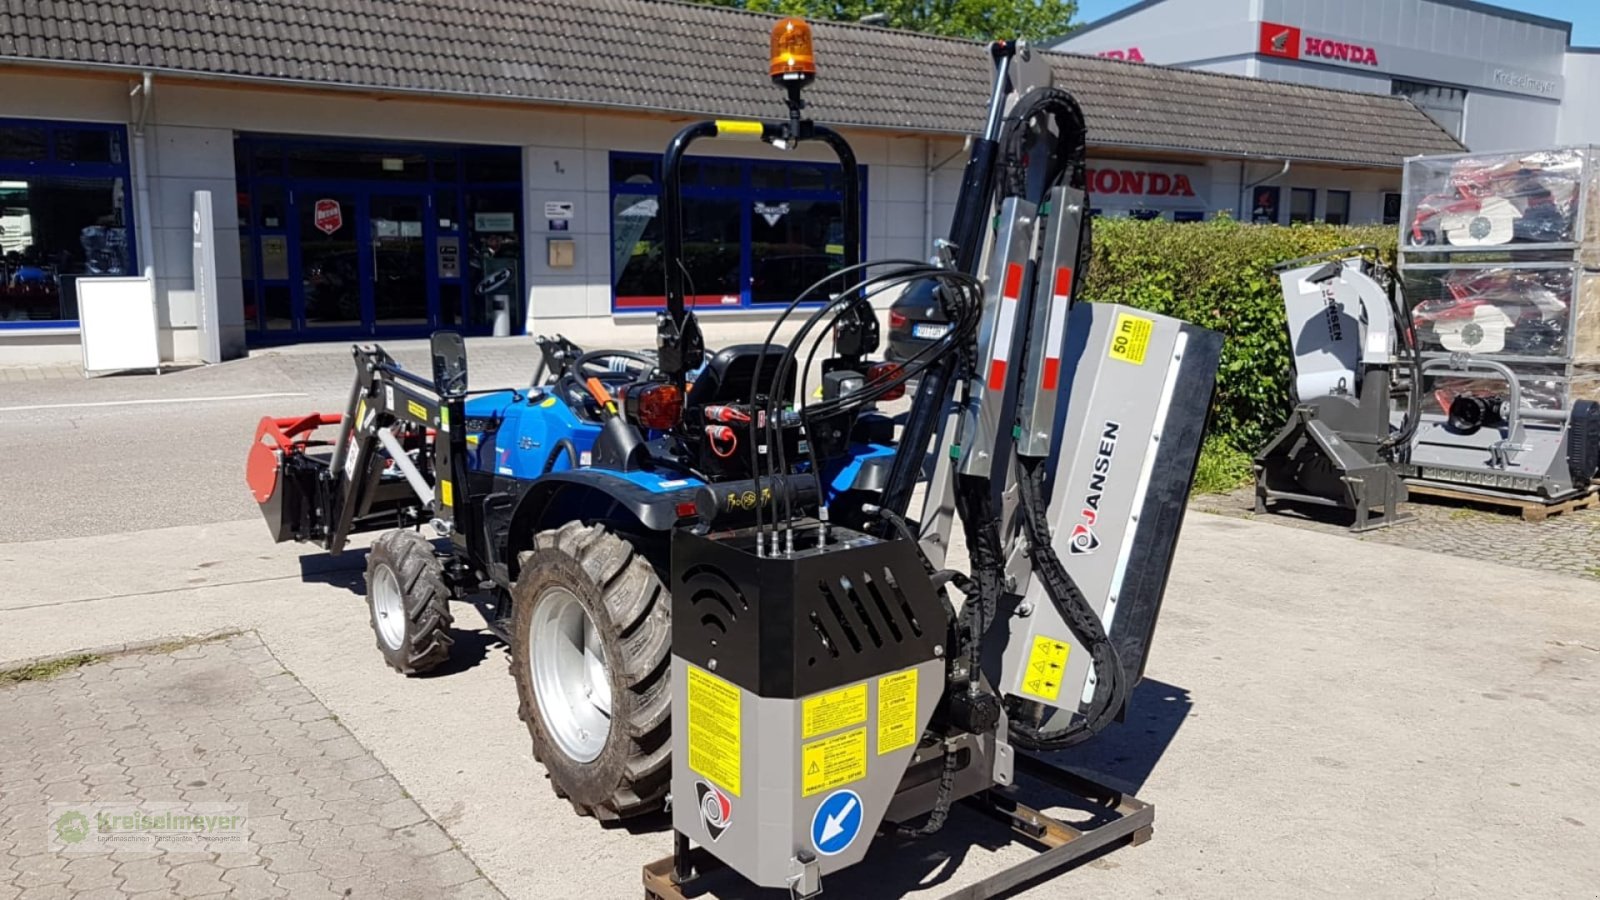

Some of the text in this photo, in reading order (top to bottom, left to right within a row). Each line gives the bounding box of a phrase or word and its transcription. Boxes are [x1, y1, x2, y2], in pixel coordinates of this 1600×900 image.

[1304, 36, 1379, 67] HONDA
[1326, 289, 1343, 341] JANSEN
[1113, 320, 1133, 354] 50 m
[1082, 421, 1120, 525] JANSEN
